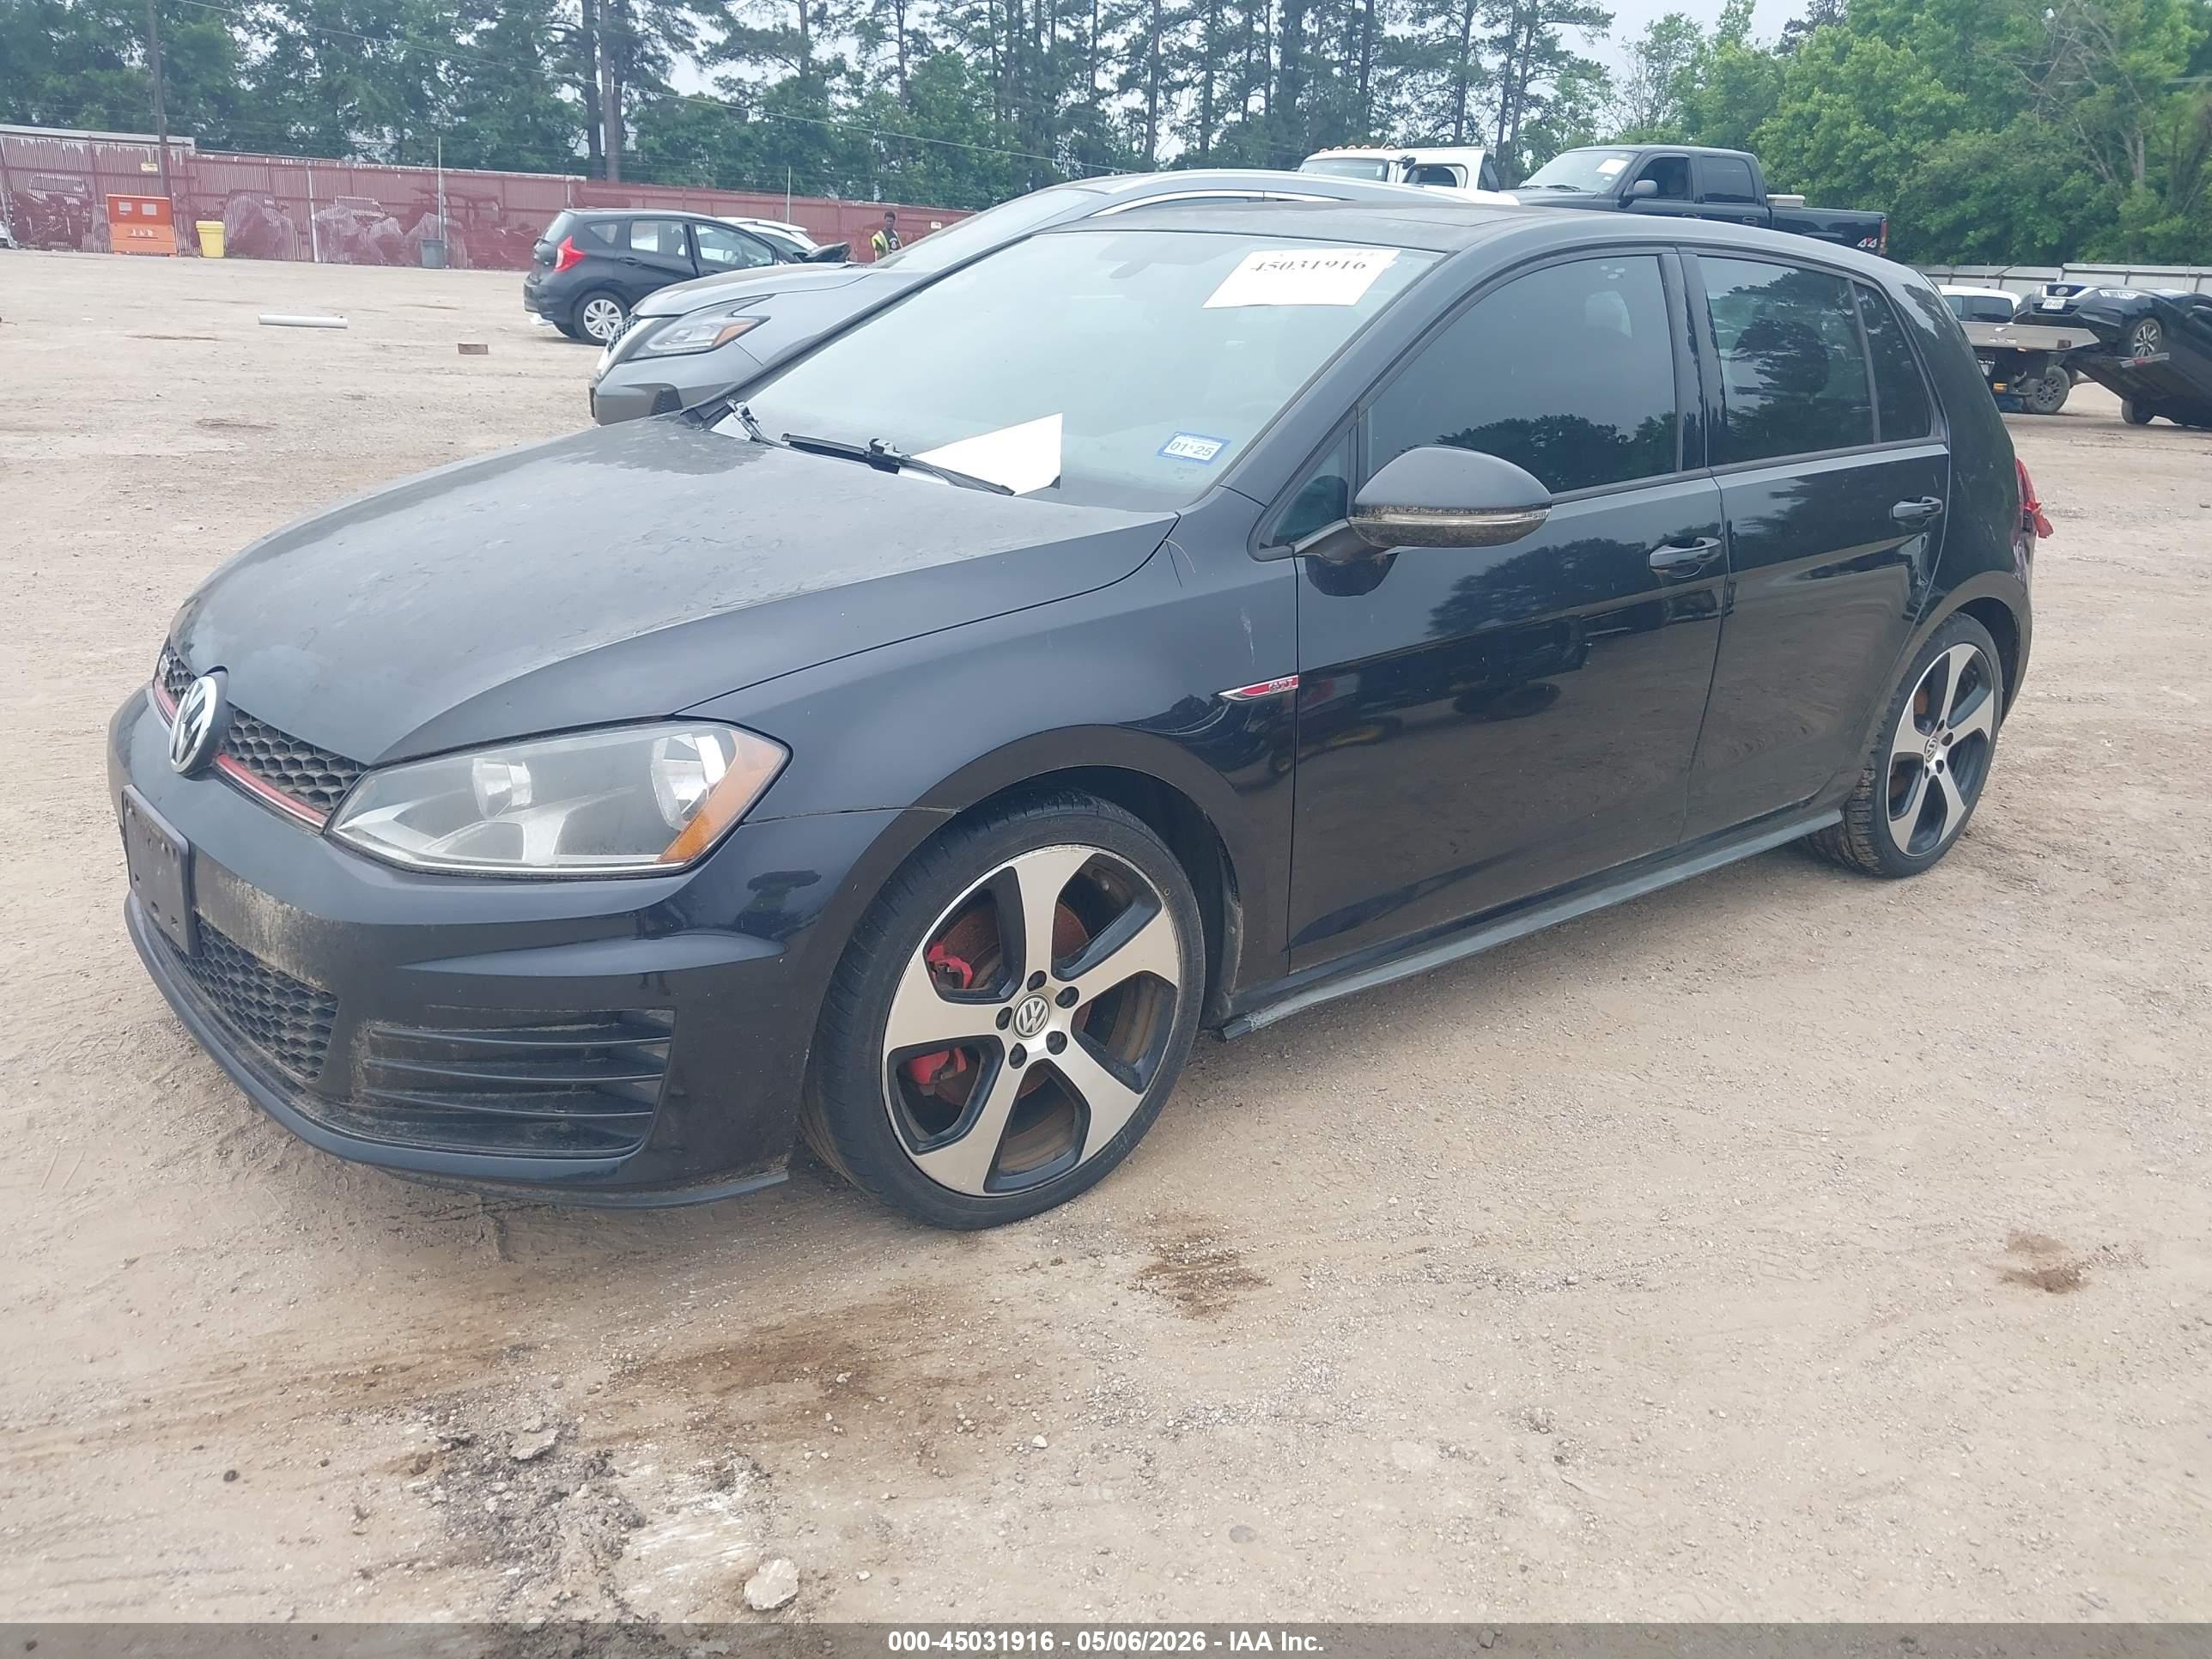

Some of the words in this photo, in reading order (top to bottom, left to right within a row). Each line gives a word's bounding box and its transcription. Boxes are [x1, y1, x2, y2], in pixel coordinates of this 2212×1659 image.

[1250, 259, 1367, 272] 45031916
[1170, 441, 1188, 453] 01
[1193, 446, 1214, 457] 25
[1015, 996, 1048, 1036] VW
